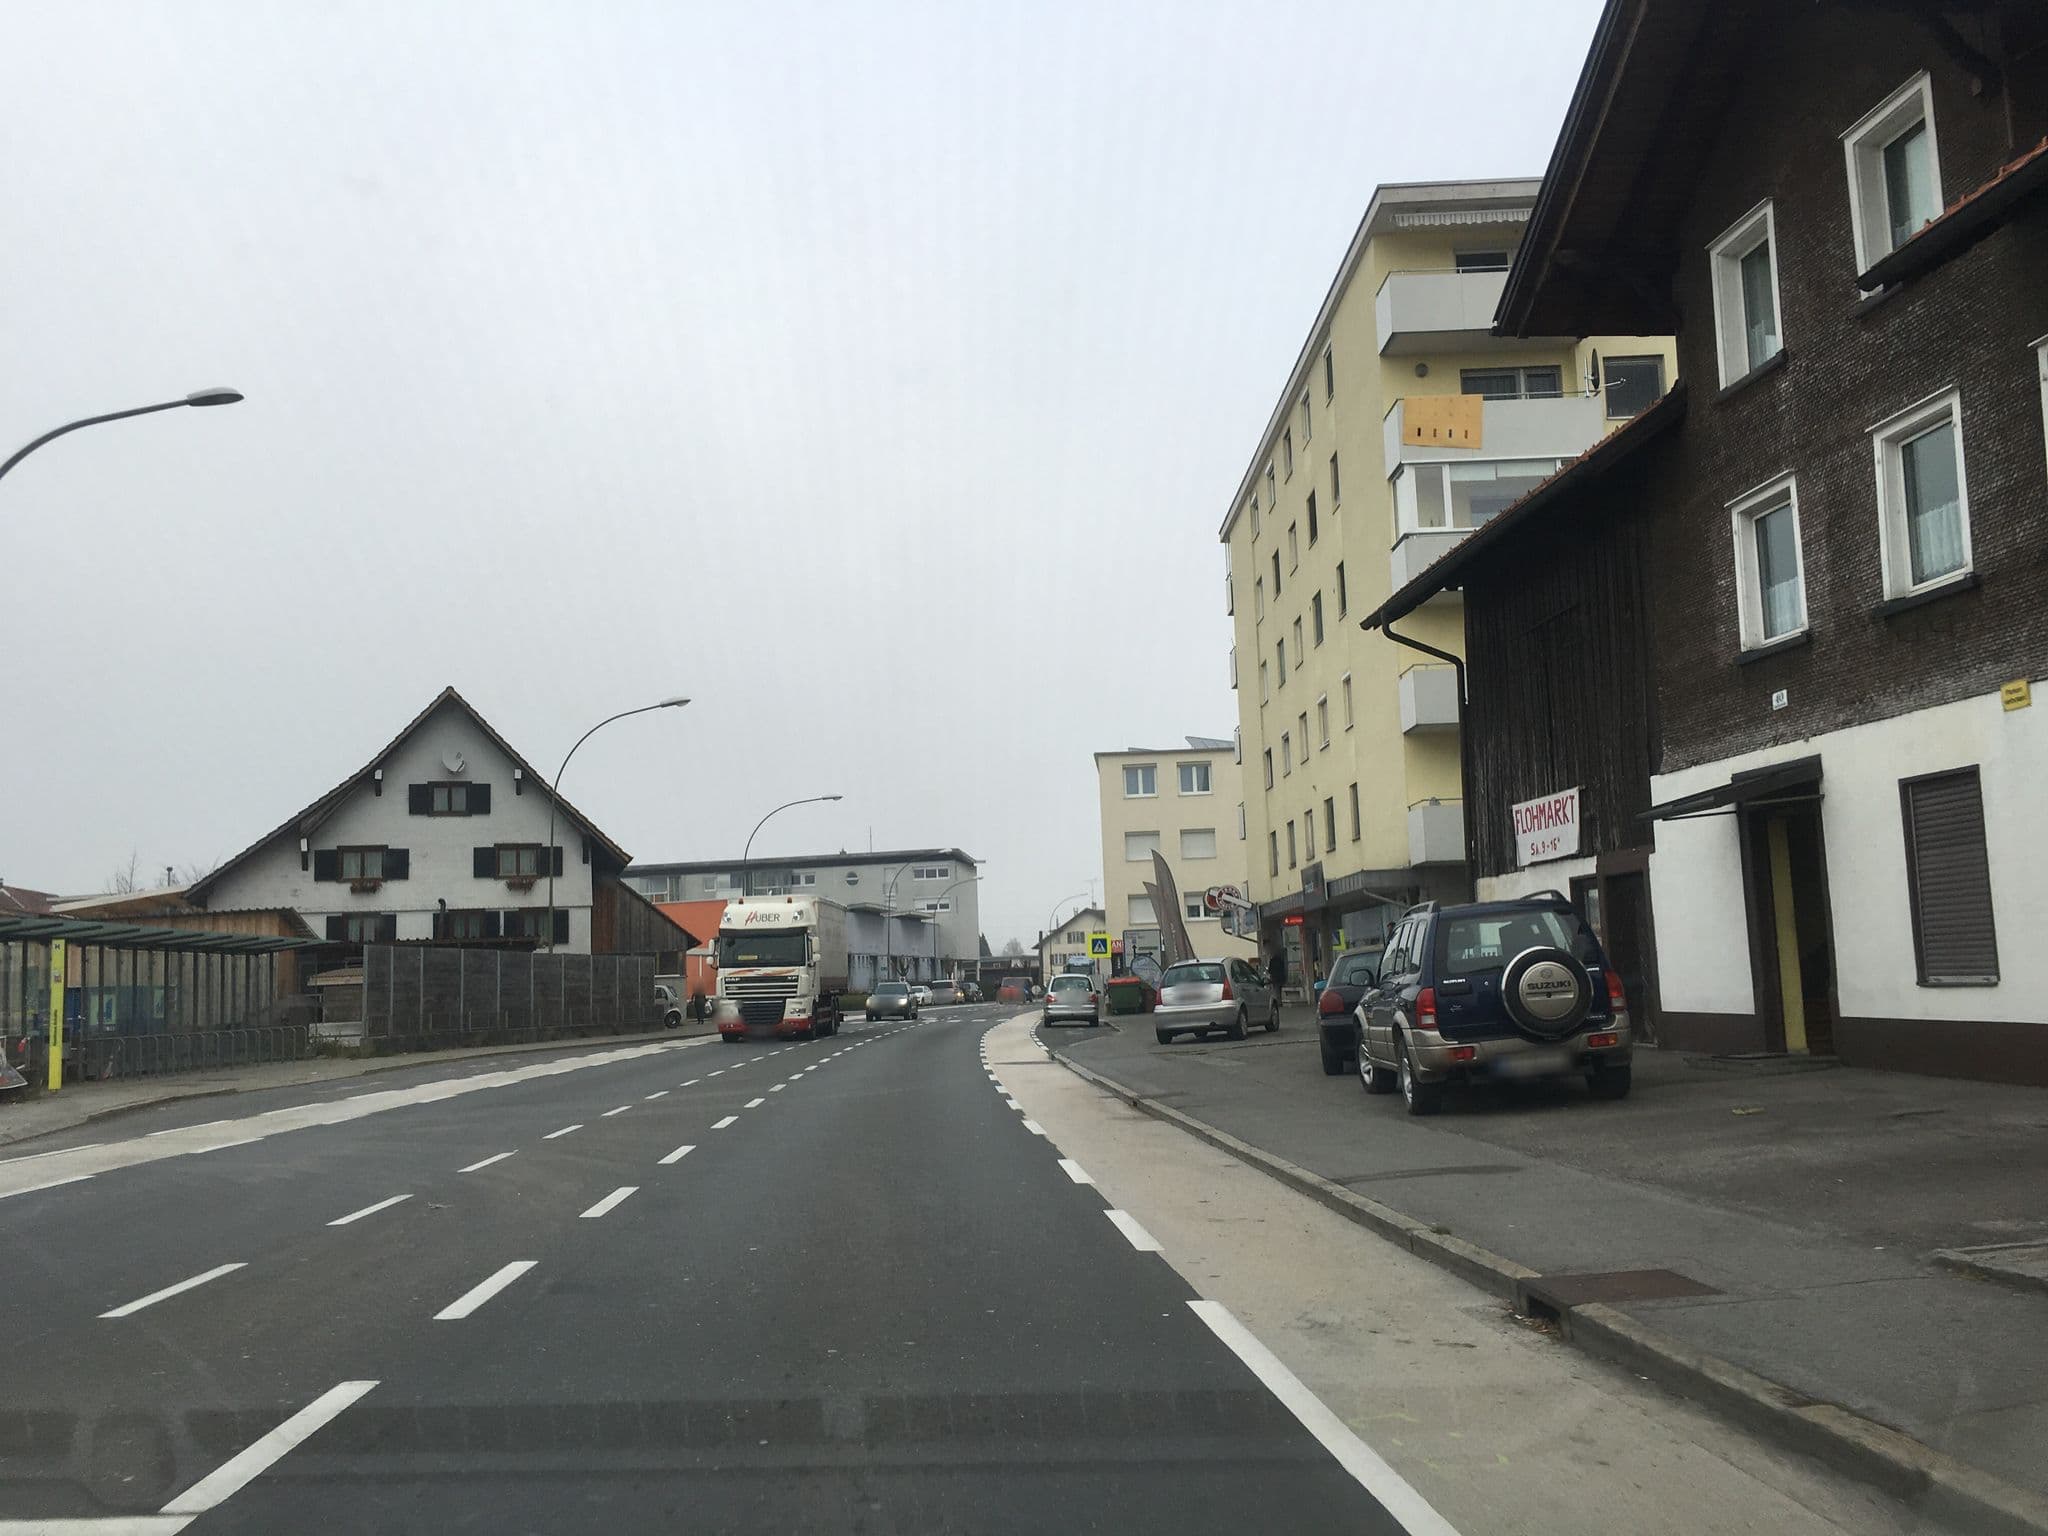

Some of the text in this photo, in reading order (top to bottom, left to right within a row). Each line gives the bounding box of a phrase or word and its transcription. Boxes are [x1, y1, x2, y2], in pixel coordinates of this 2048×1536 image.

[1514, 794, 1575, 835] FLOHMARKT
[744, 910, 782, 926] HUBER
[1526, 979, 1572, 991] SUZUKI
